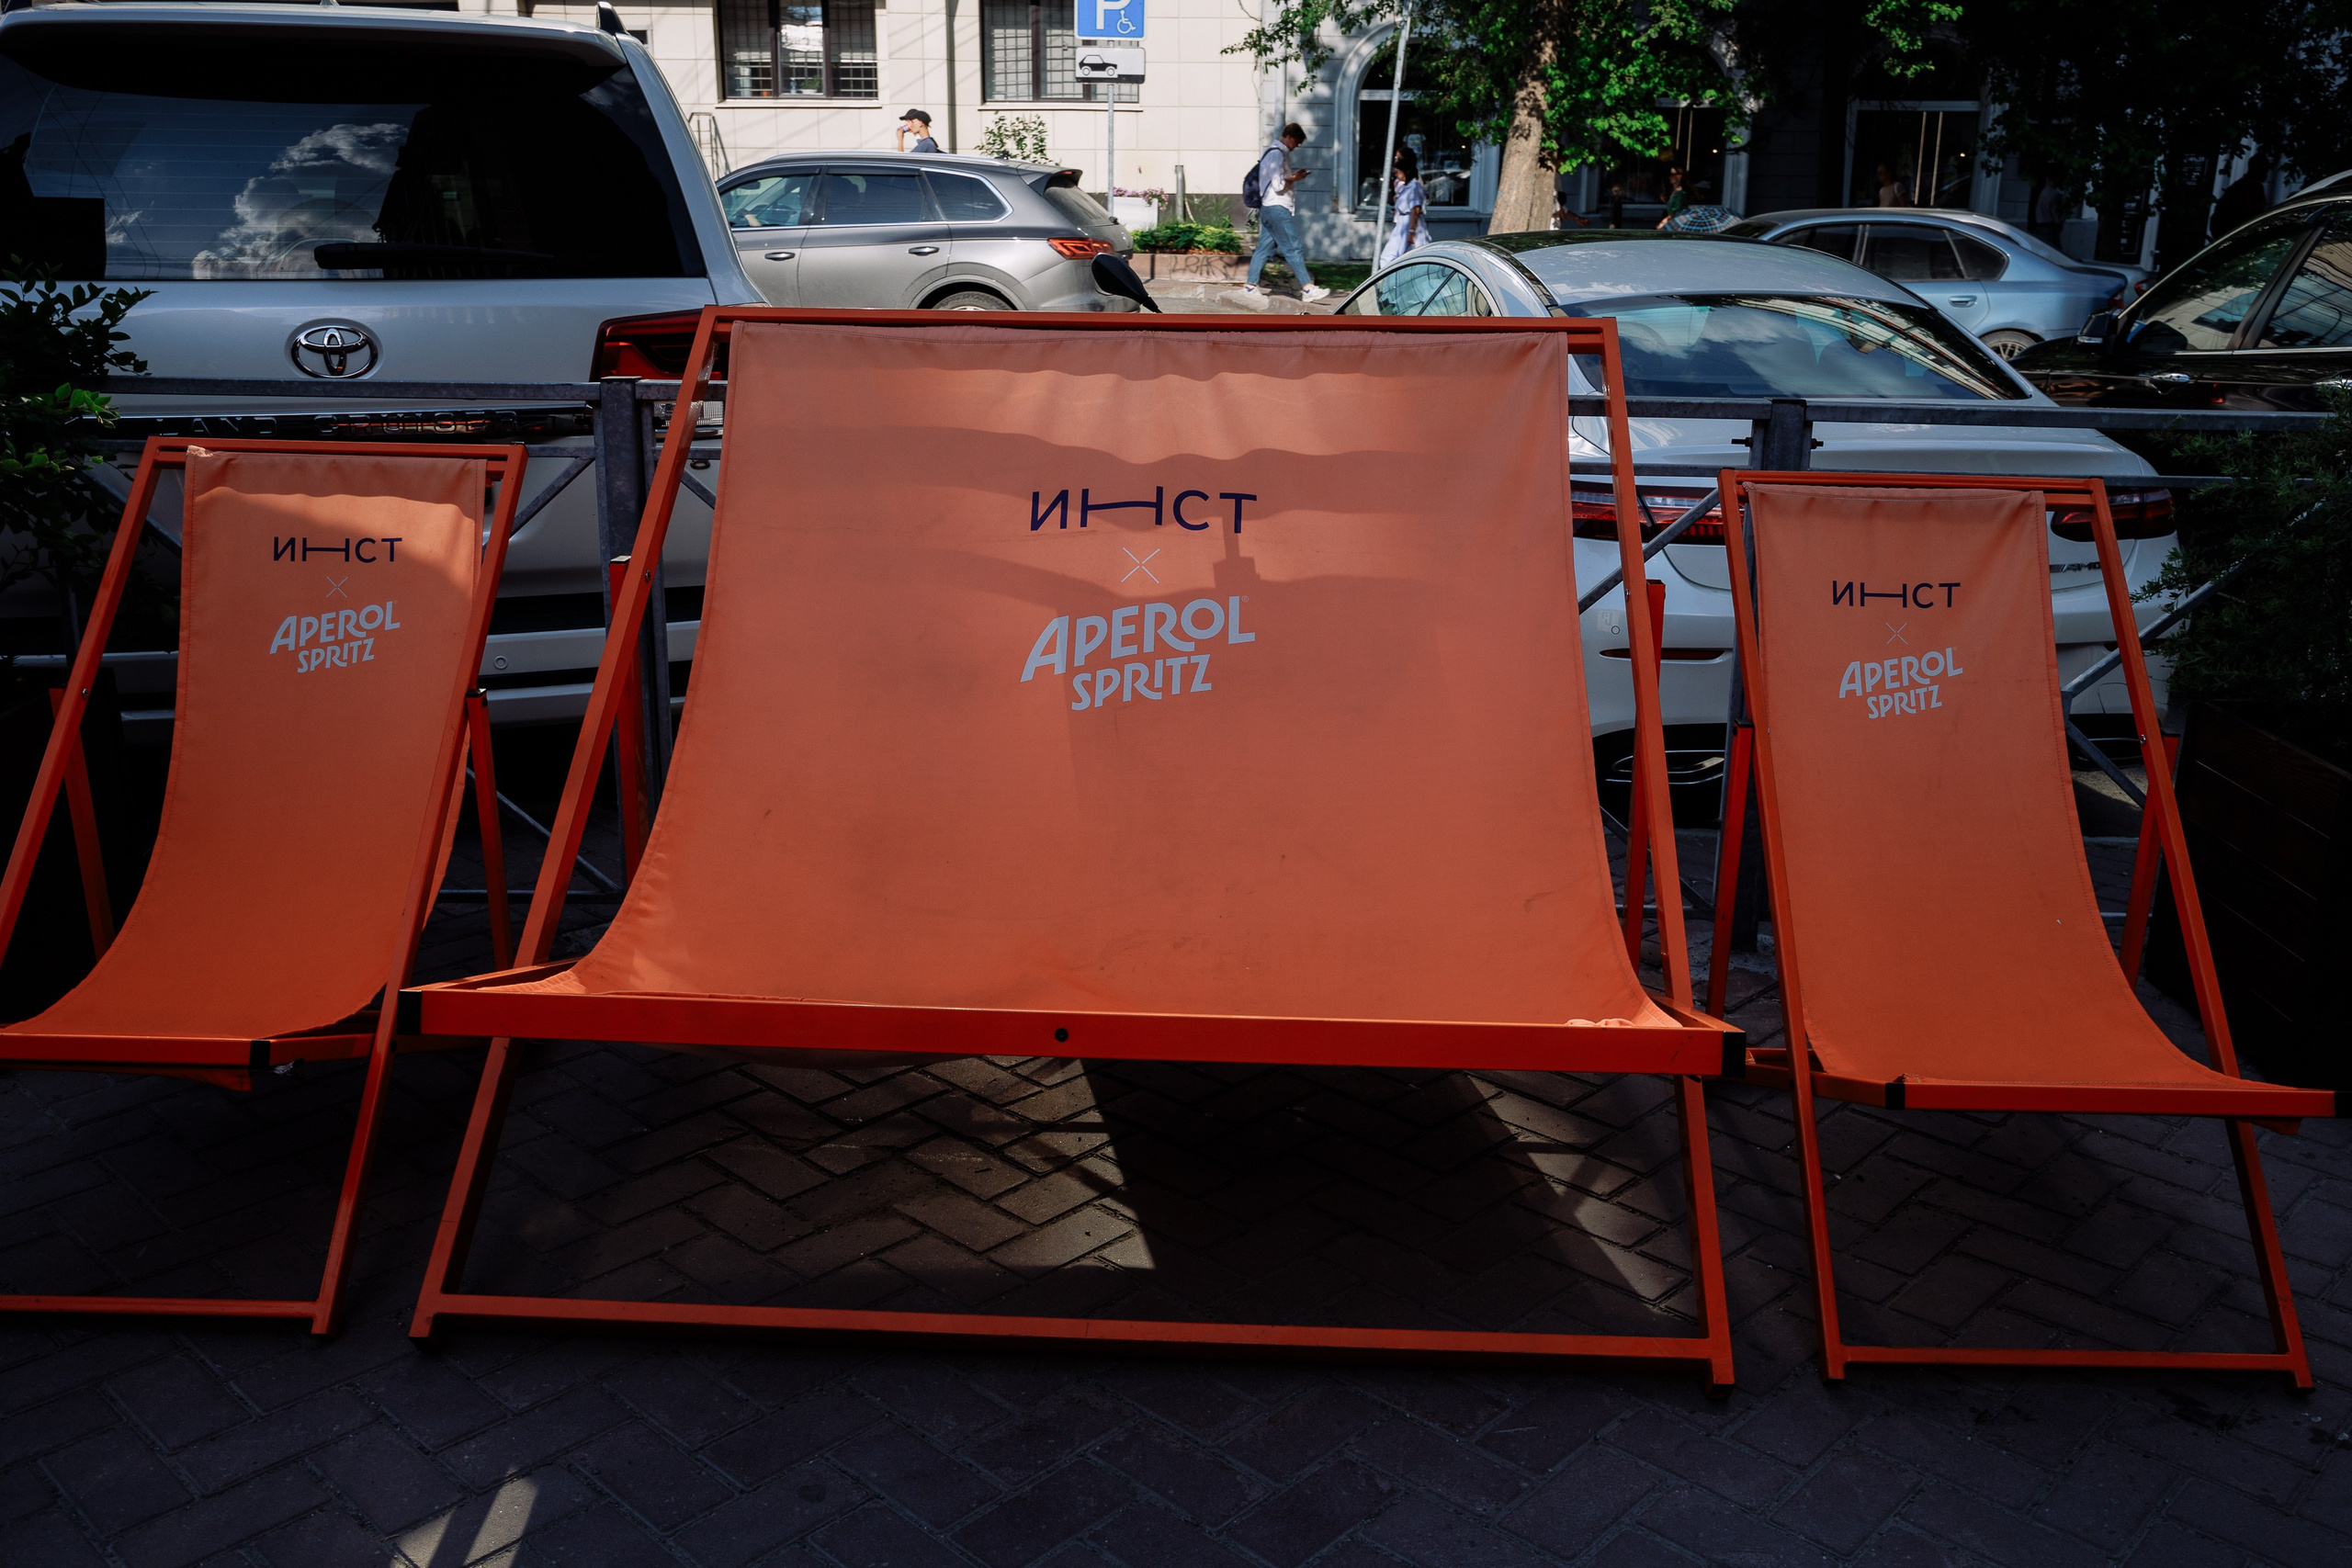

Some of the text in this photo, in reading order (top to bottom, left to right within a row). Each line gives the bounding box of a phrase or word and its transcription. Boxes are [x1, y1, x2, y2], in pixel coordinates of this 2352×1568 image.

[155, 410, 518, 437] LAND CRUISER
[1030, 485, 1257, 534] ИНСТ
[274, 536, 402, 563] ИНСТ
[1832, 580, 1961, 608] ИНСТ
[269, 601, 401, 654] APEROL
[1020, 595, 1256, 682] APEROL
[297, 637, 375, 673] SPRITZ
[1838, 647, 1963, 698] APEROL
[1071, 653, 1212, 711] SPRITZ
[1866, 684, 1943, 719] SPRITZ
